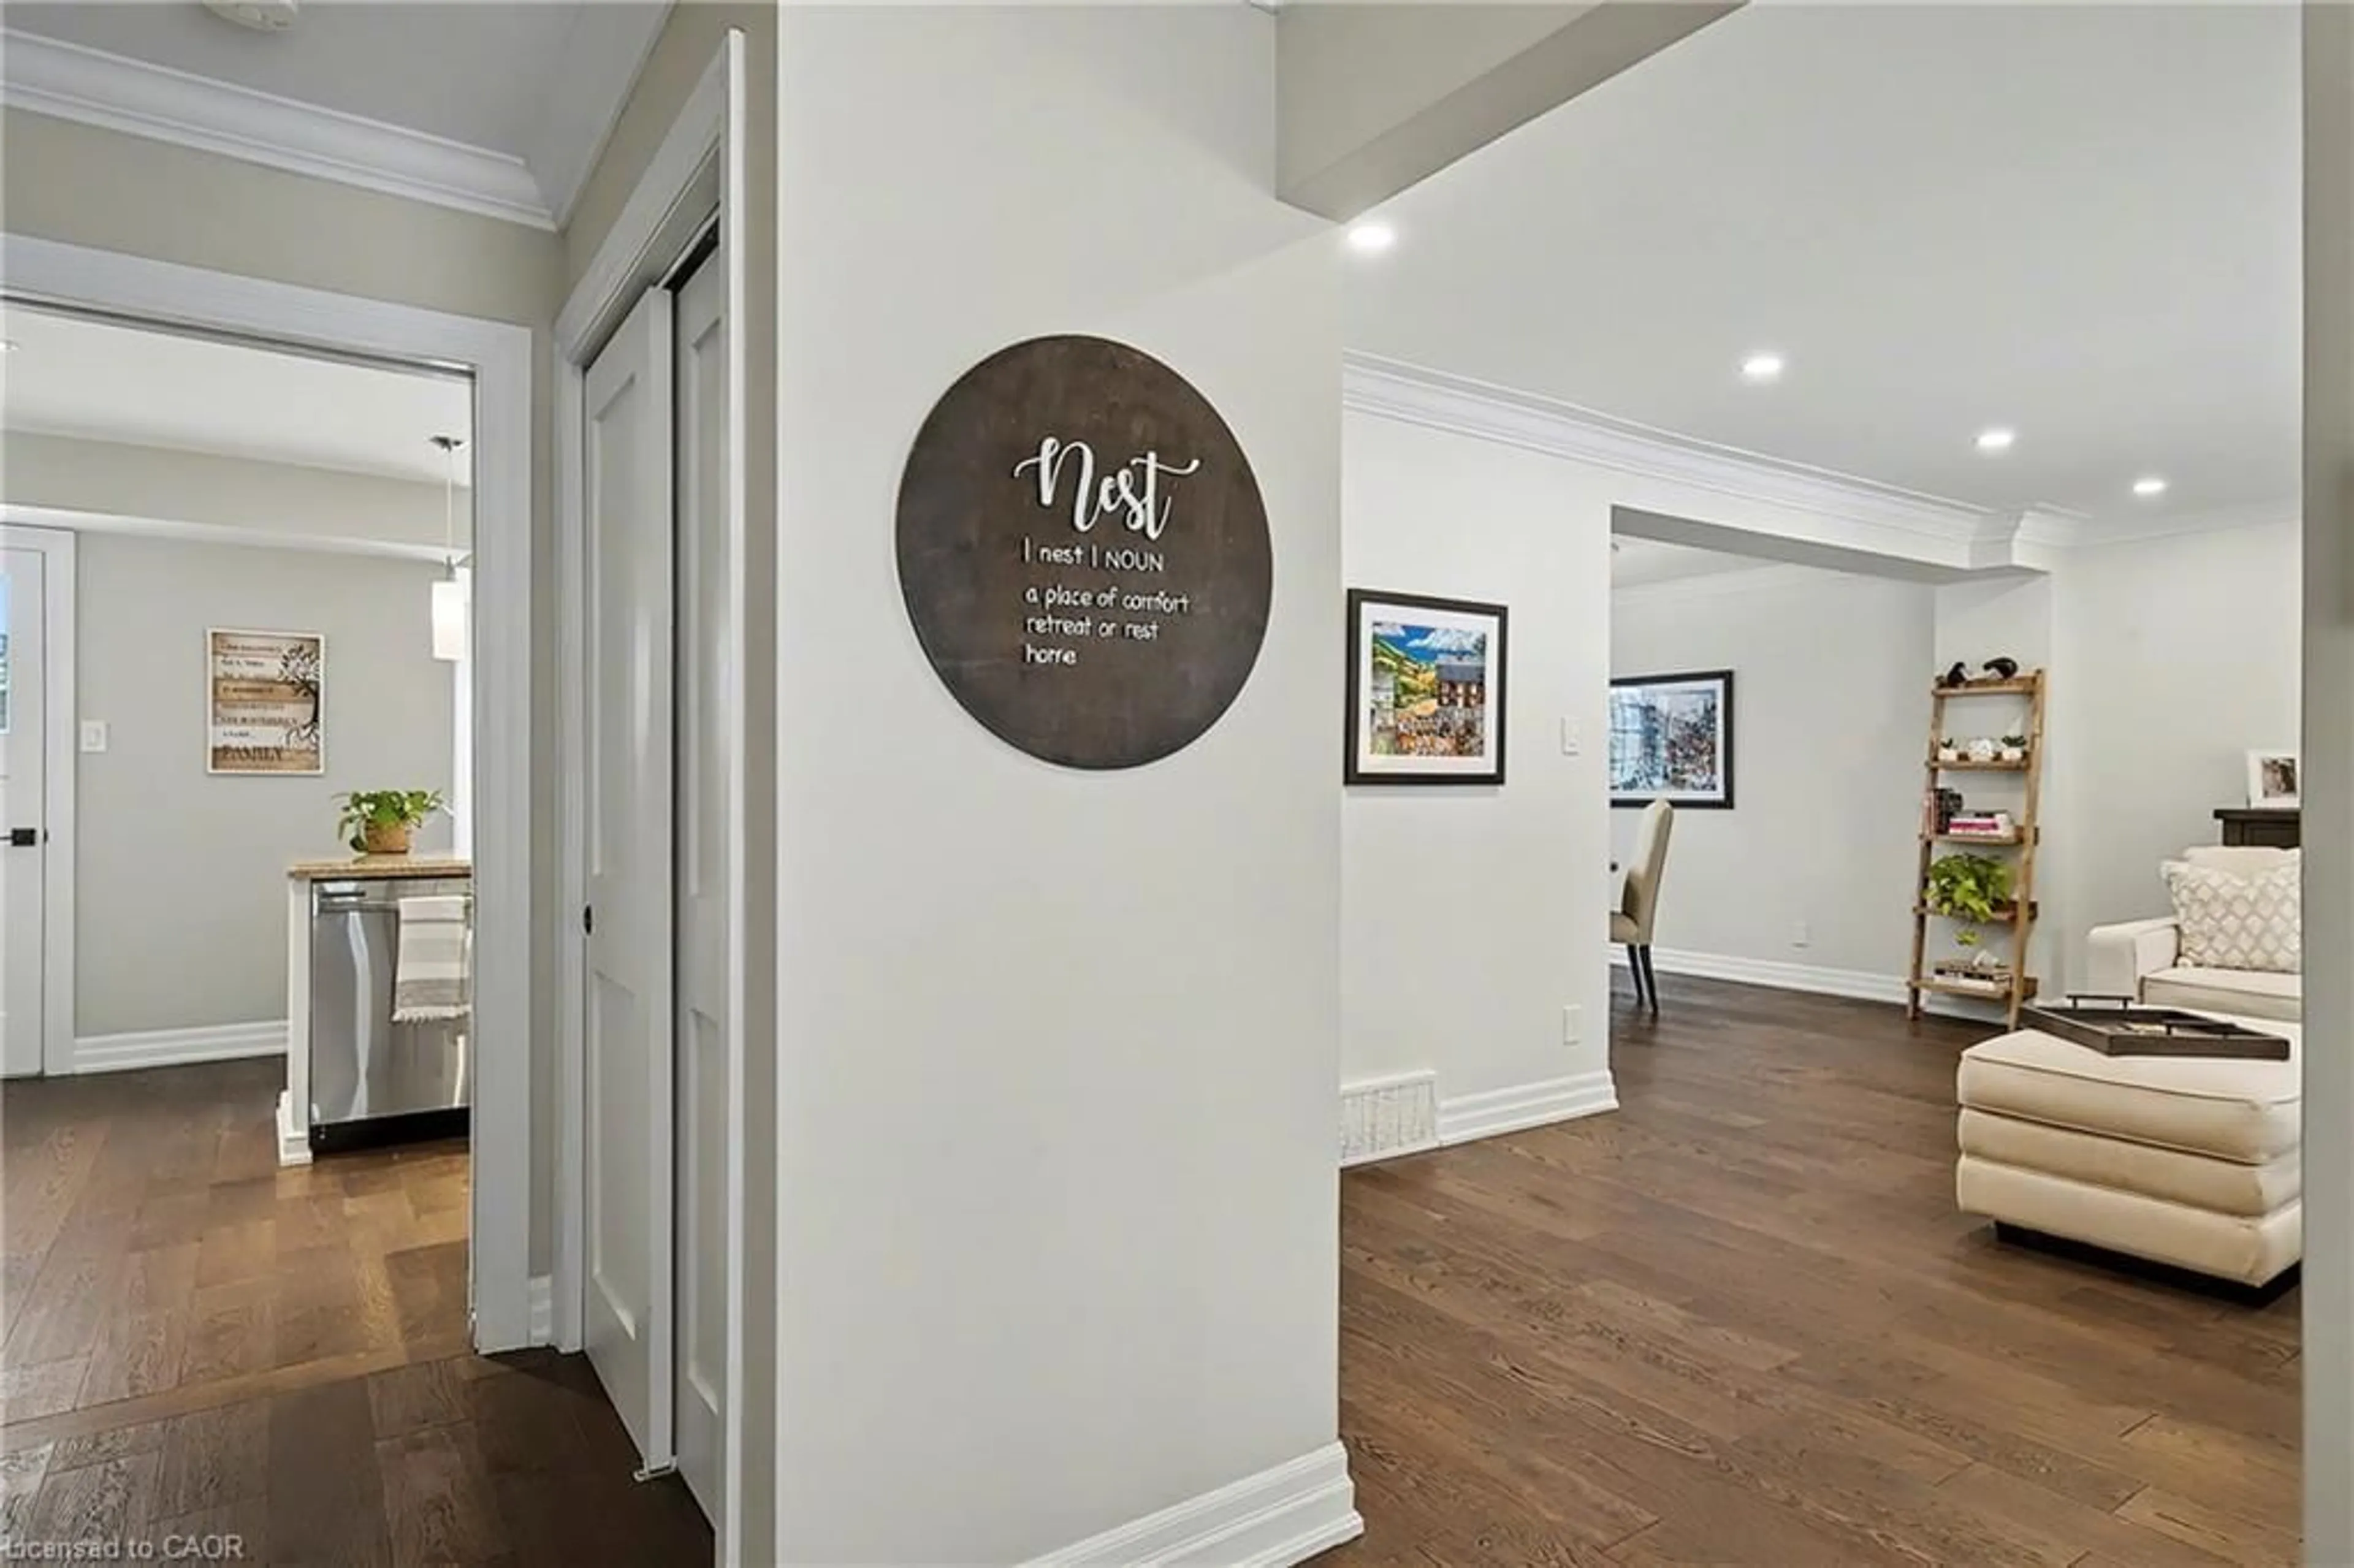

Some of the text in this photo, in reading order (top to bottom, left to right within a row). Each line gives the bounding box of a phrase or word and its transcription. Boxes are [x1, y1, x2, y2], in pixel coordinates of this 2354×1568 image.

[1013, 436, 1200, 541] Nest
[1040, 546, 1083, 565] nest
[1105, 550, 1164, 572] NOUN
[1025, 584, 1190, 613] a place of comfort
[1026, 614, 1160, 639] retreat or rest
